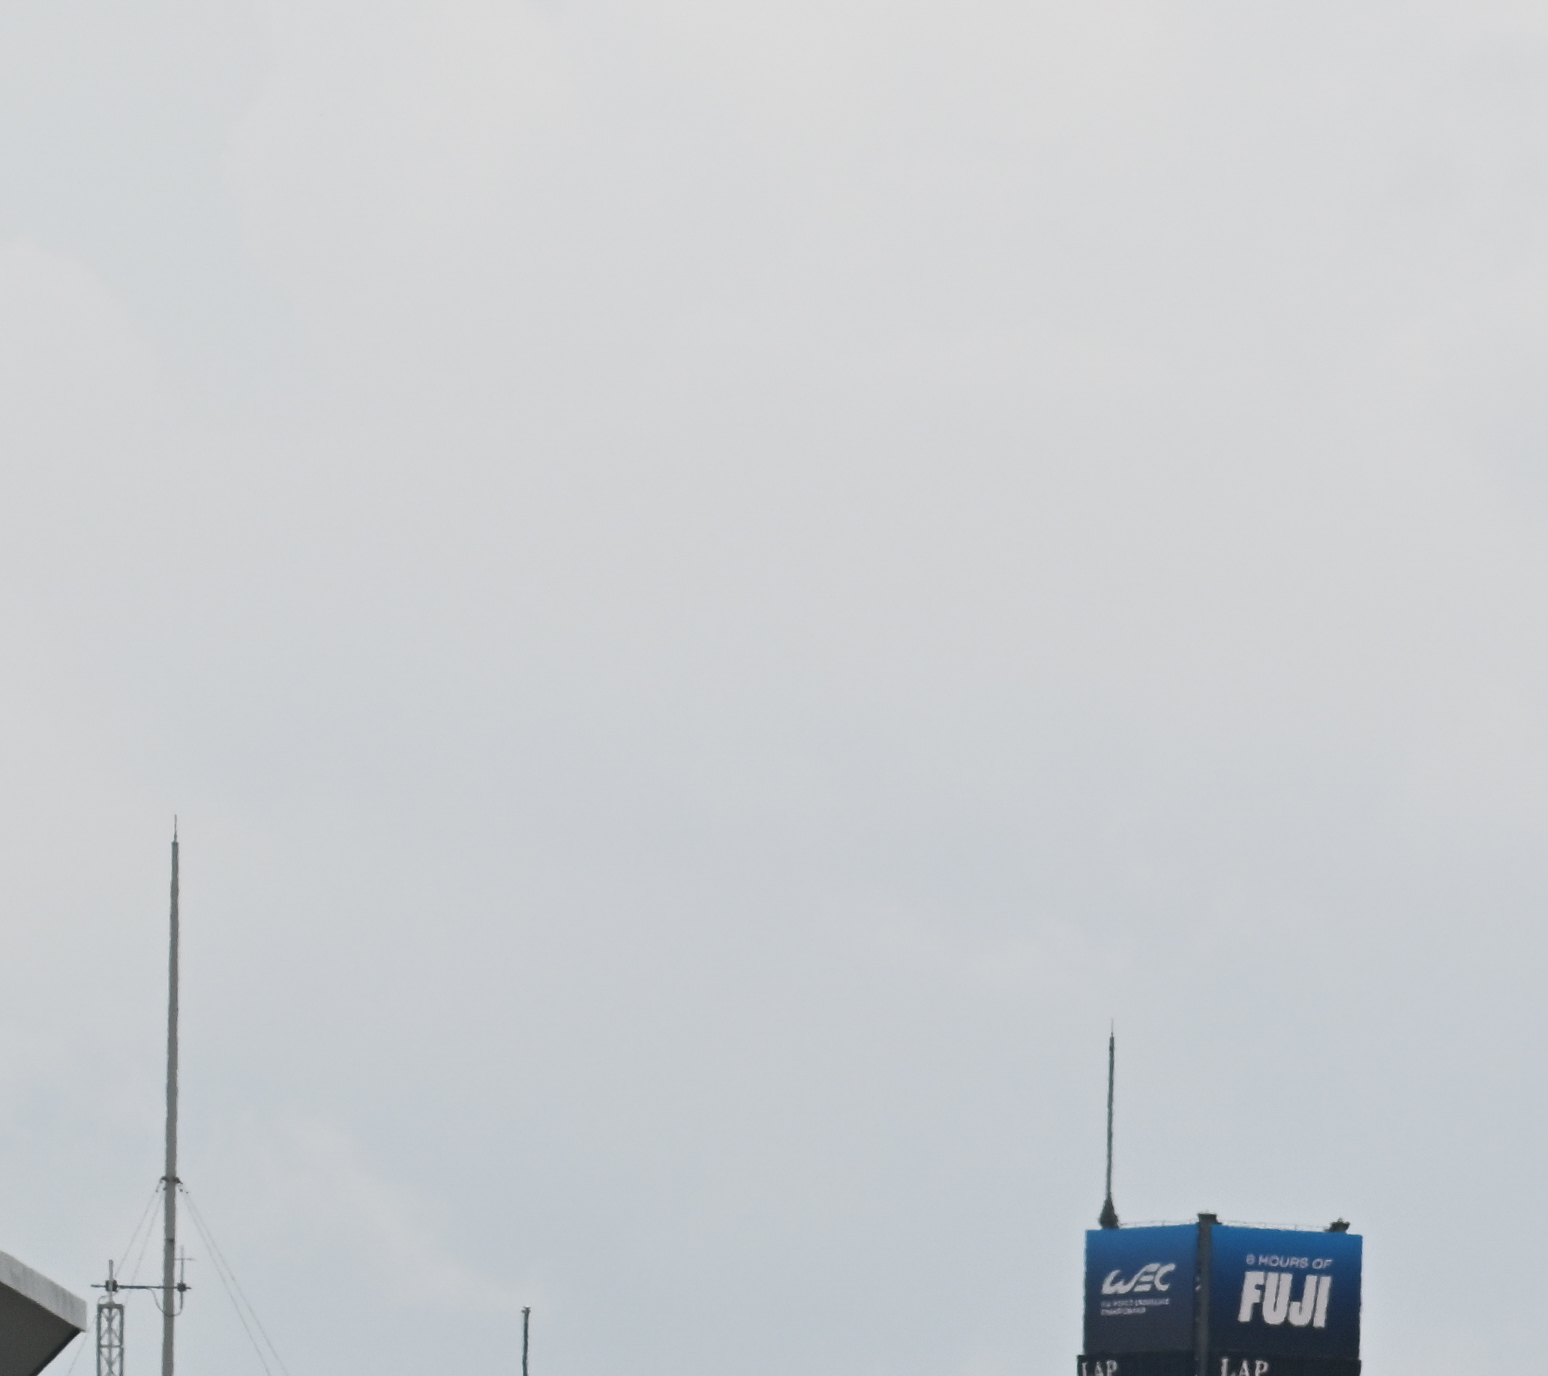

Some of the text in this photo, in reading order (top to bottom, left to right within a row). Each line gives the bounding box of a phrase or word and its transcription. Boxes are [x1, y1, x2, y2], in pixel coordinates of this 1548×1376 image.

[1102, 1263, 1176, 1294] WEC
[1259, 1256, 1308, 1269] HOURS
[1312, 1259, 1332, 1270] OF
[1238, 1271, 1332, 1328] FUJI
